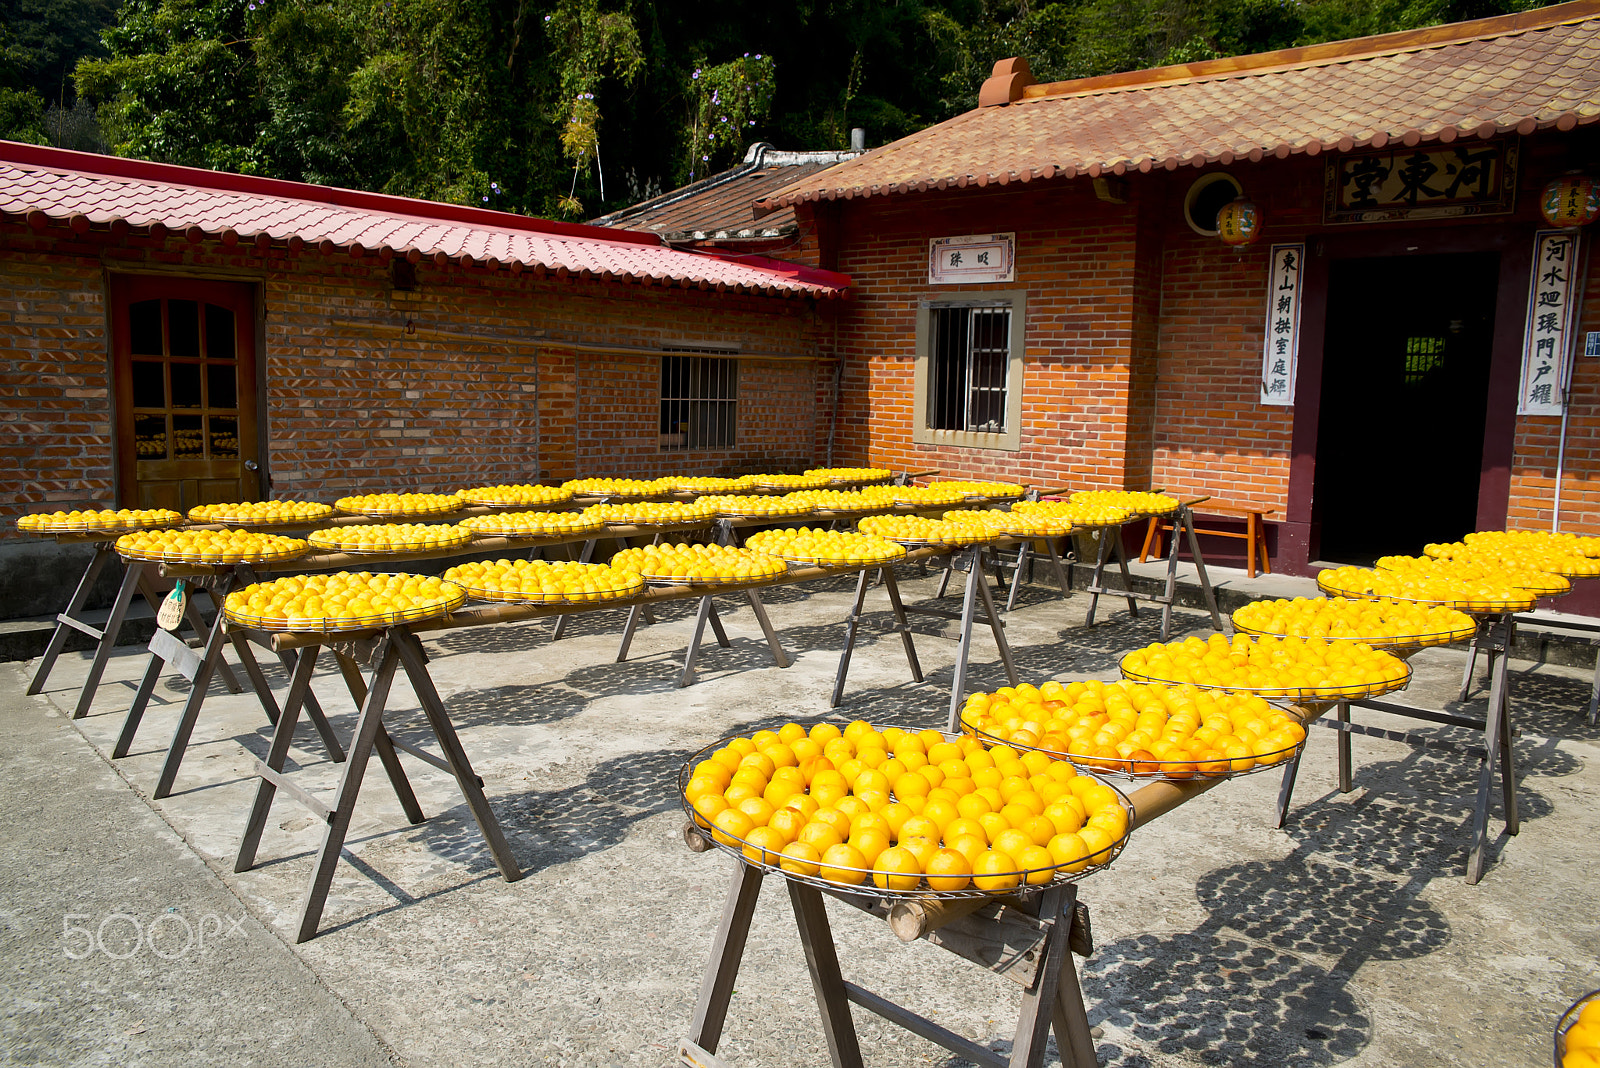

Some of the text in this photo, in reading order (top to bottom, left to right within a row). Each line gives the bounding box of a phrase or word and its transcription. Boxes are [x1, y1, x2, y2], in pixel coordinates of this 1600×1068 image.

[1269, 251, 1297, 397] 東山朝拱室庭輝
